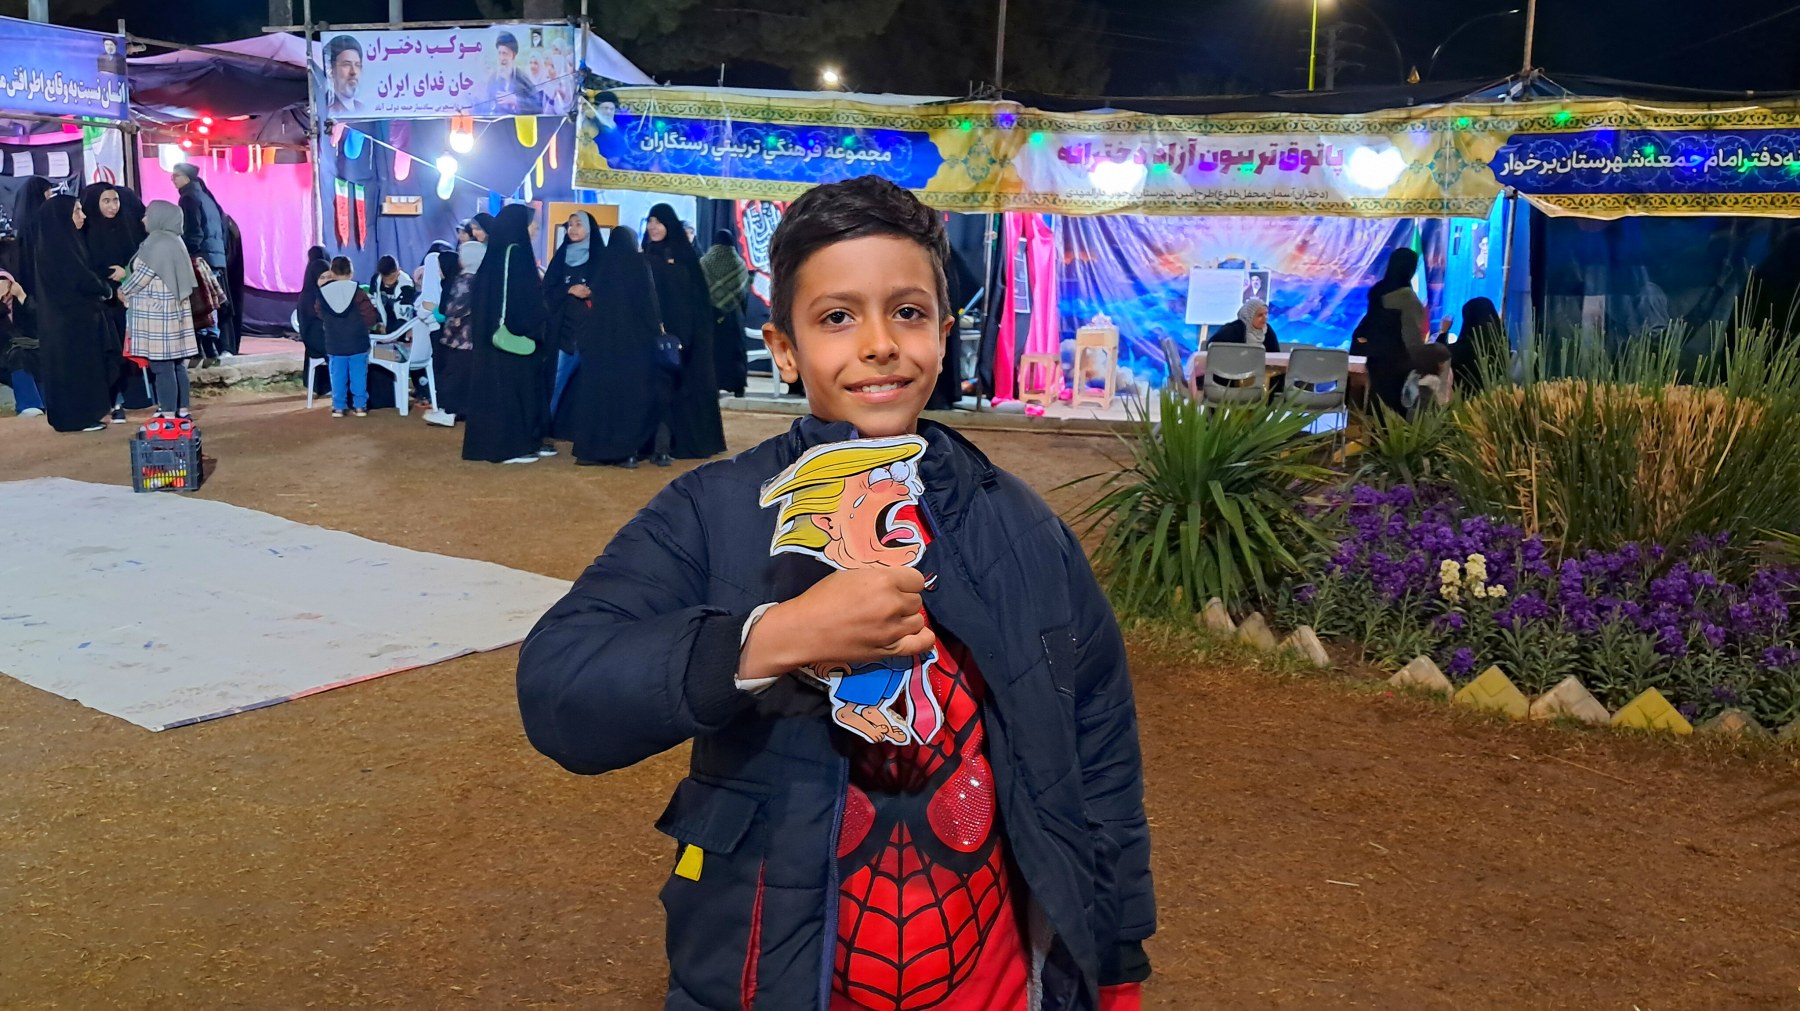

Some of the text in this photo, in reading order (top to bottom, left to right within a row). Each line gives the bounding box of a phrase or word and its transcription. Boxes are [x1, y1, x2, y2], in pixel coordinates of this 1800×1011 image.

[366, 34, 482, 61] موکب دختران
[6, 65, 44, 99] اطرافش
[68, 80, 78, 105] به
[77, 78, 101, 105] نسبت
[101, 78, 126, 109] انسان
[377, 70, 474, 98] جان فدای ایران
[640, 131, 709, 156] رستگاران
[824, 146, 892, 166] مجموعه
[1057, 138, 1344, 176] پاتوق تریبون آزاد دخترانه
[1499, 152, 1557, 176] برخوار
[1556, 150, 1645, 174] شهرستان
[1644, 152, 1705, 173] جمعه
[1703, 147, 1743, 173] امام
[1737, 146, 1783, 173] دفتر
